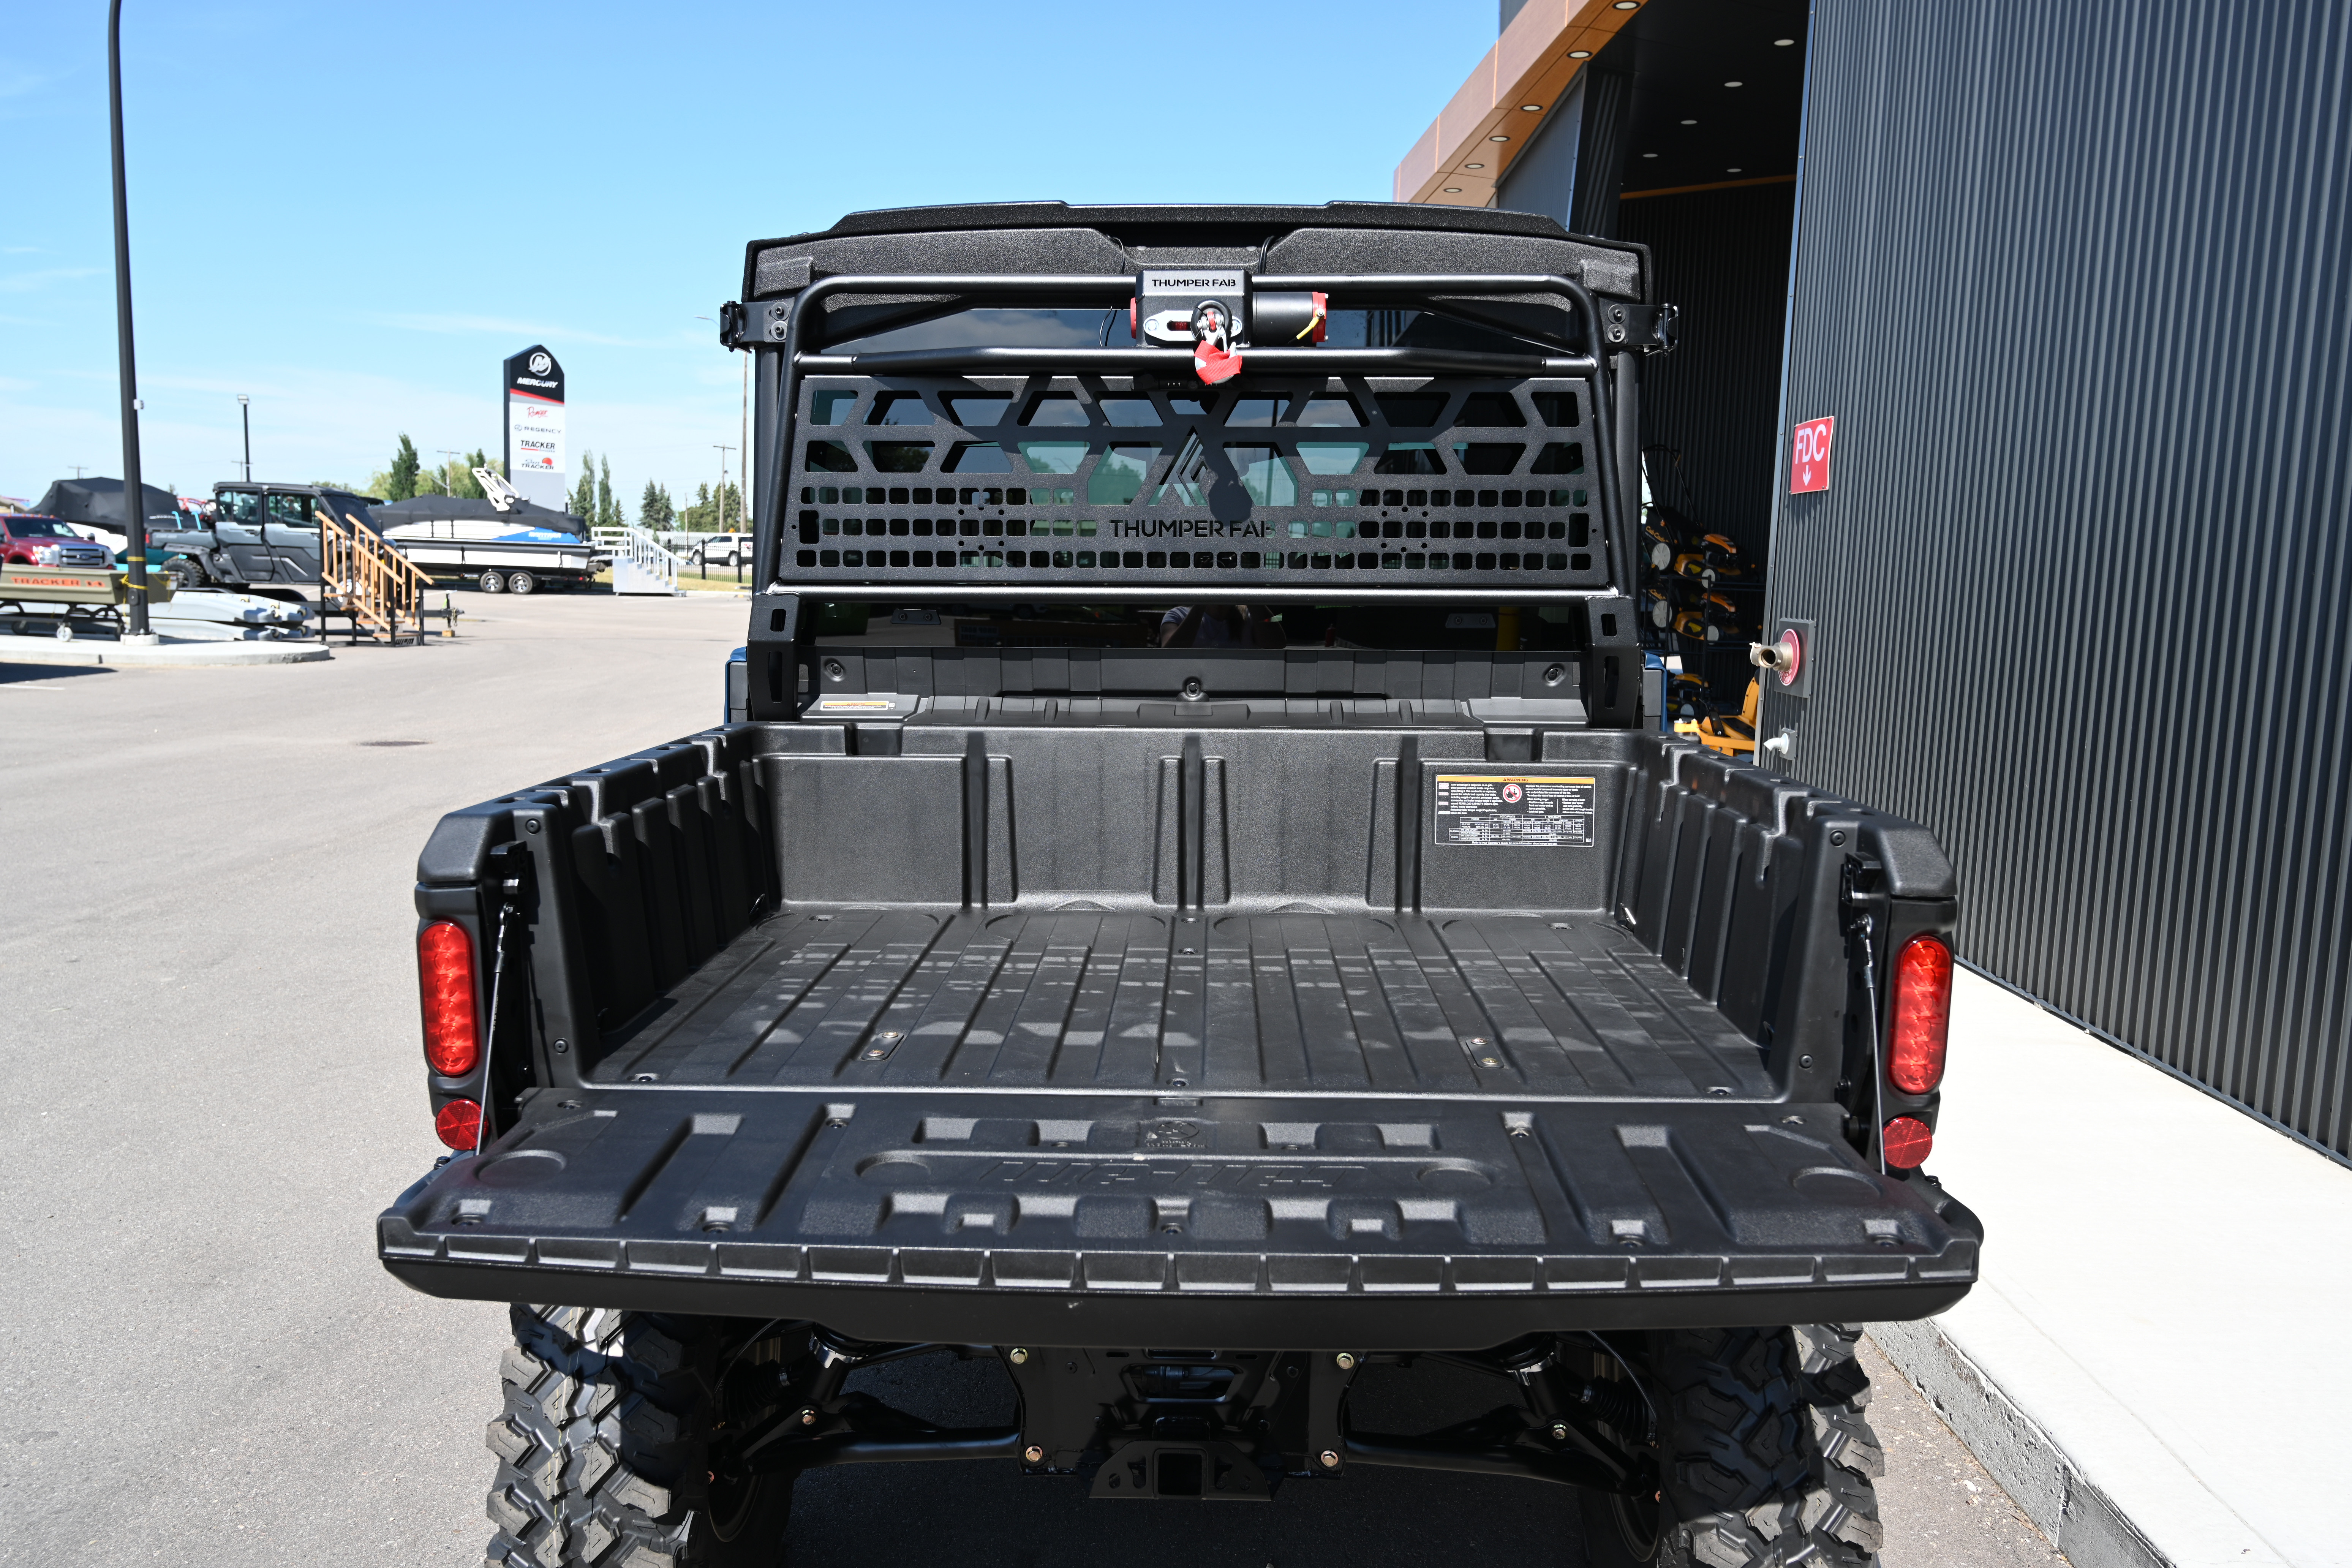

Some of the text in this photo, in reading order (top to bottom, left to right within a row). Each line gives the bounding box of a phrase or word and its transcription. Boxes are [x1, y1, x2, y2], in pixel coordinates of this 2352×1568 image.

[517, 377, 558, 388] MERCURY
[521, 440, 555, 449] TRACKER
[1795, 424, 1826, 464] FDC
[1109, 520, 1276, 538] THUMPER FAB
[11, 577, 81, 586] TRACKER
